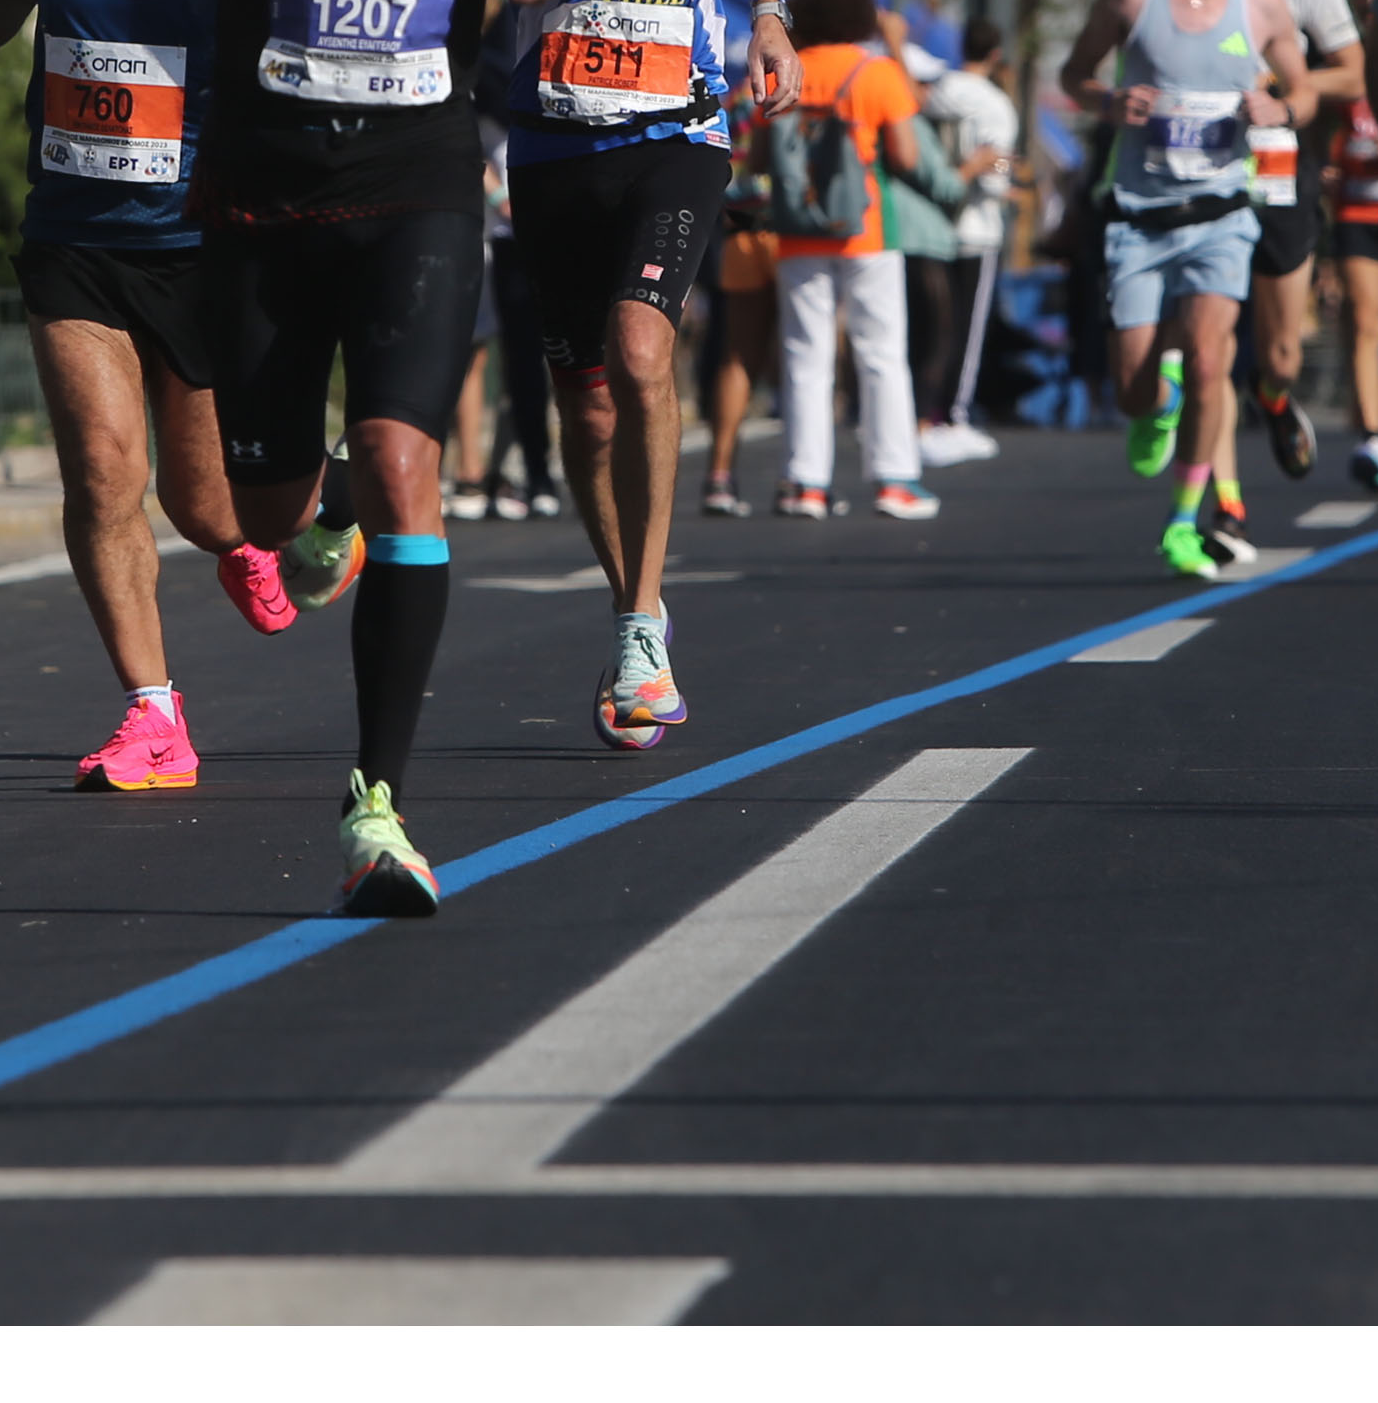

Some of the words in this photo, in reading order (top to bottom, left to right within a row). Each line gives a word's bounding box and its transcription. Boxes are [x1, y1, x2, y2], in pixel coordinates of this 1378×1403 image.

[584, 41, 643, 78] 511
[368, 76, 406, 93] ΕΡΤ
[588, 76, 613, 88] PATRICE
[614, 79, 638, 91] ROBERT
[74, 84, 134, 123] 760
[108, 156, 139, 171] ΕΡΤ
